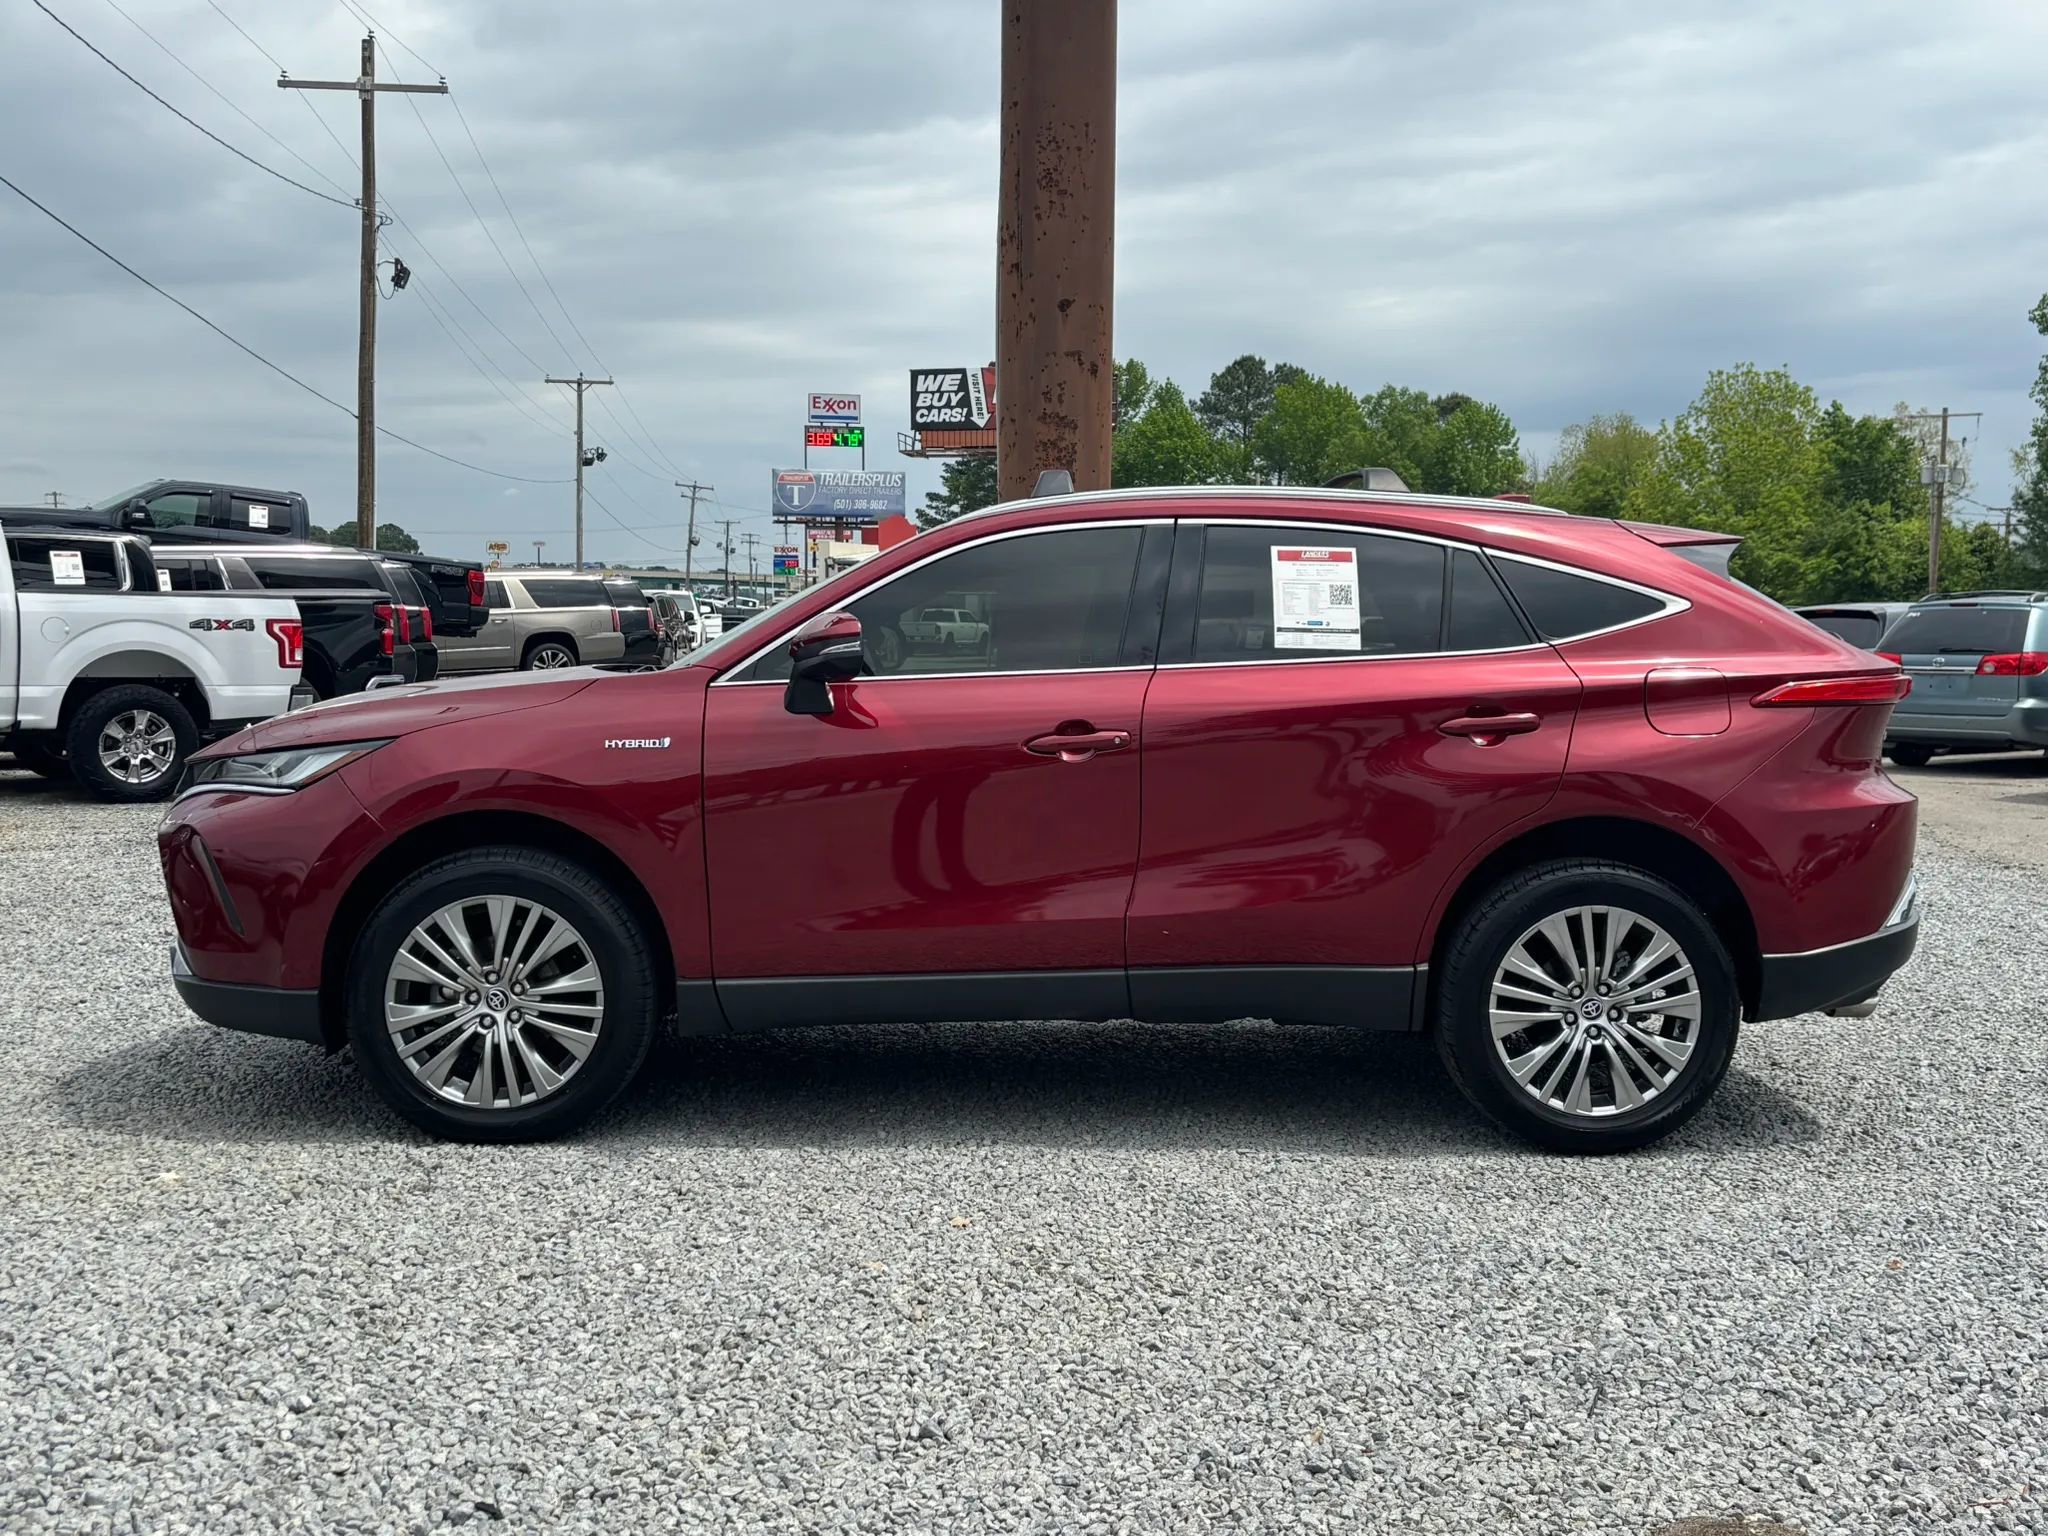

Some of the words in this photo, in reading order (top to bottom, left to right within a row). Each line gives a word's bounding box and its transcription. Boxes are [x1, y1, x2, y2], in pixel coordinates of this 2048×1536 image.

[916, 374, 962, 392] WE
[971, 373, 981, 395] VISIT
[812, 396, 857, 414] Exxon
[916, 392, 965, 407] BUY
[915, 408, 968, 423] CARS!
[975, 396, 985, 420] HERE!
[820, 472, 903, 487] TRAILERSPLUS
[818, 486, 847, 495] FACTORY
[849, 486, 873, 495] DIRECT
[873, 487, 903, 496] TRAILERS
[833, 500, 852, 511] (501)
[604, 739, 661, 749] HYBRID
